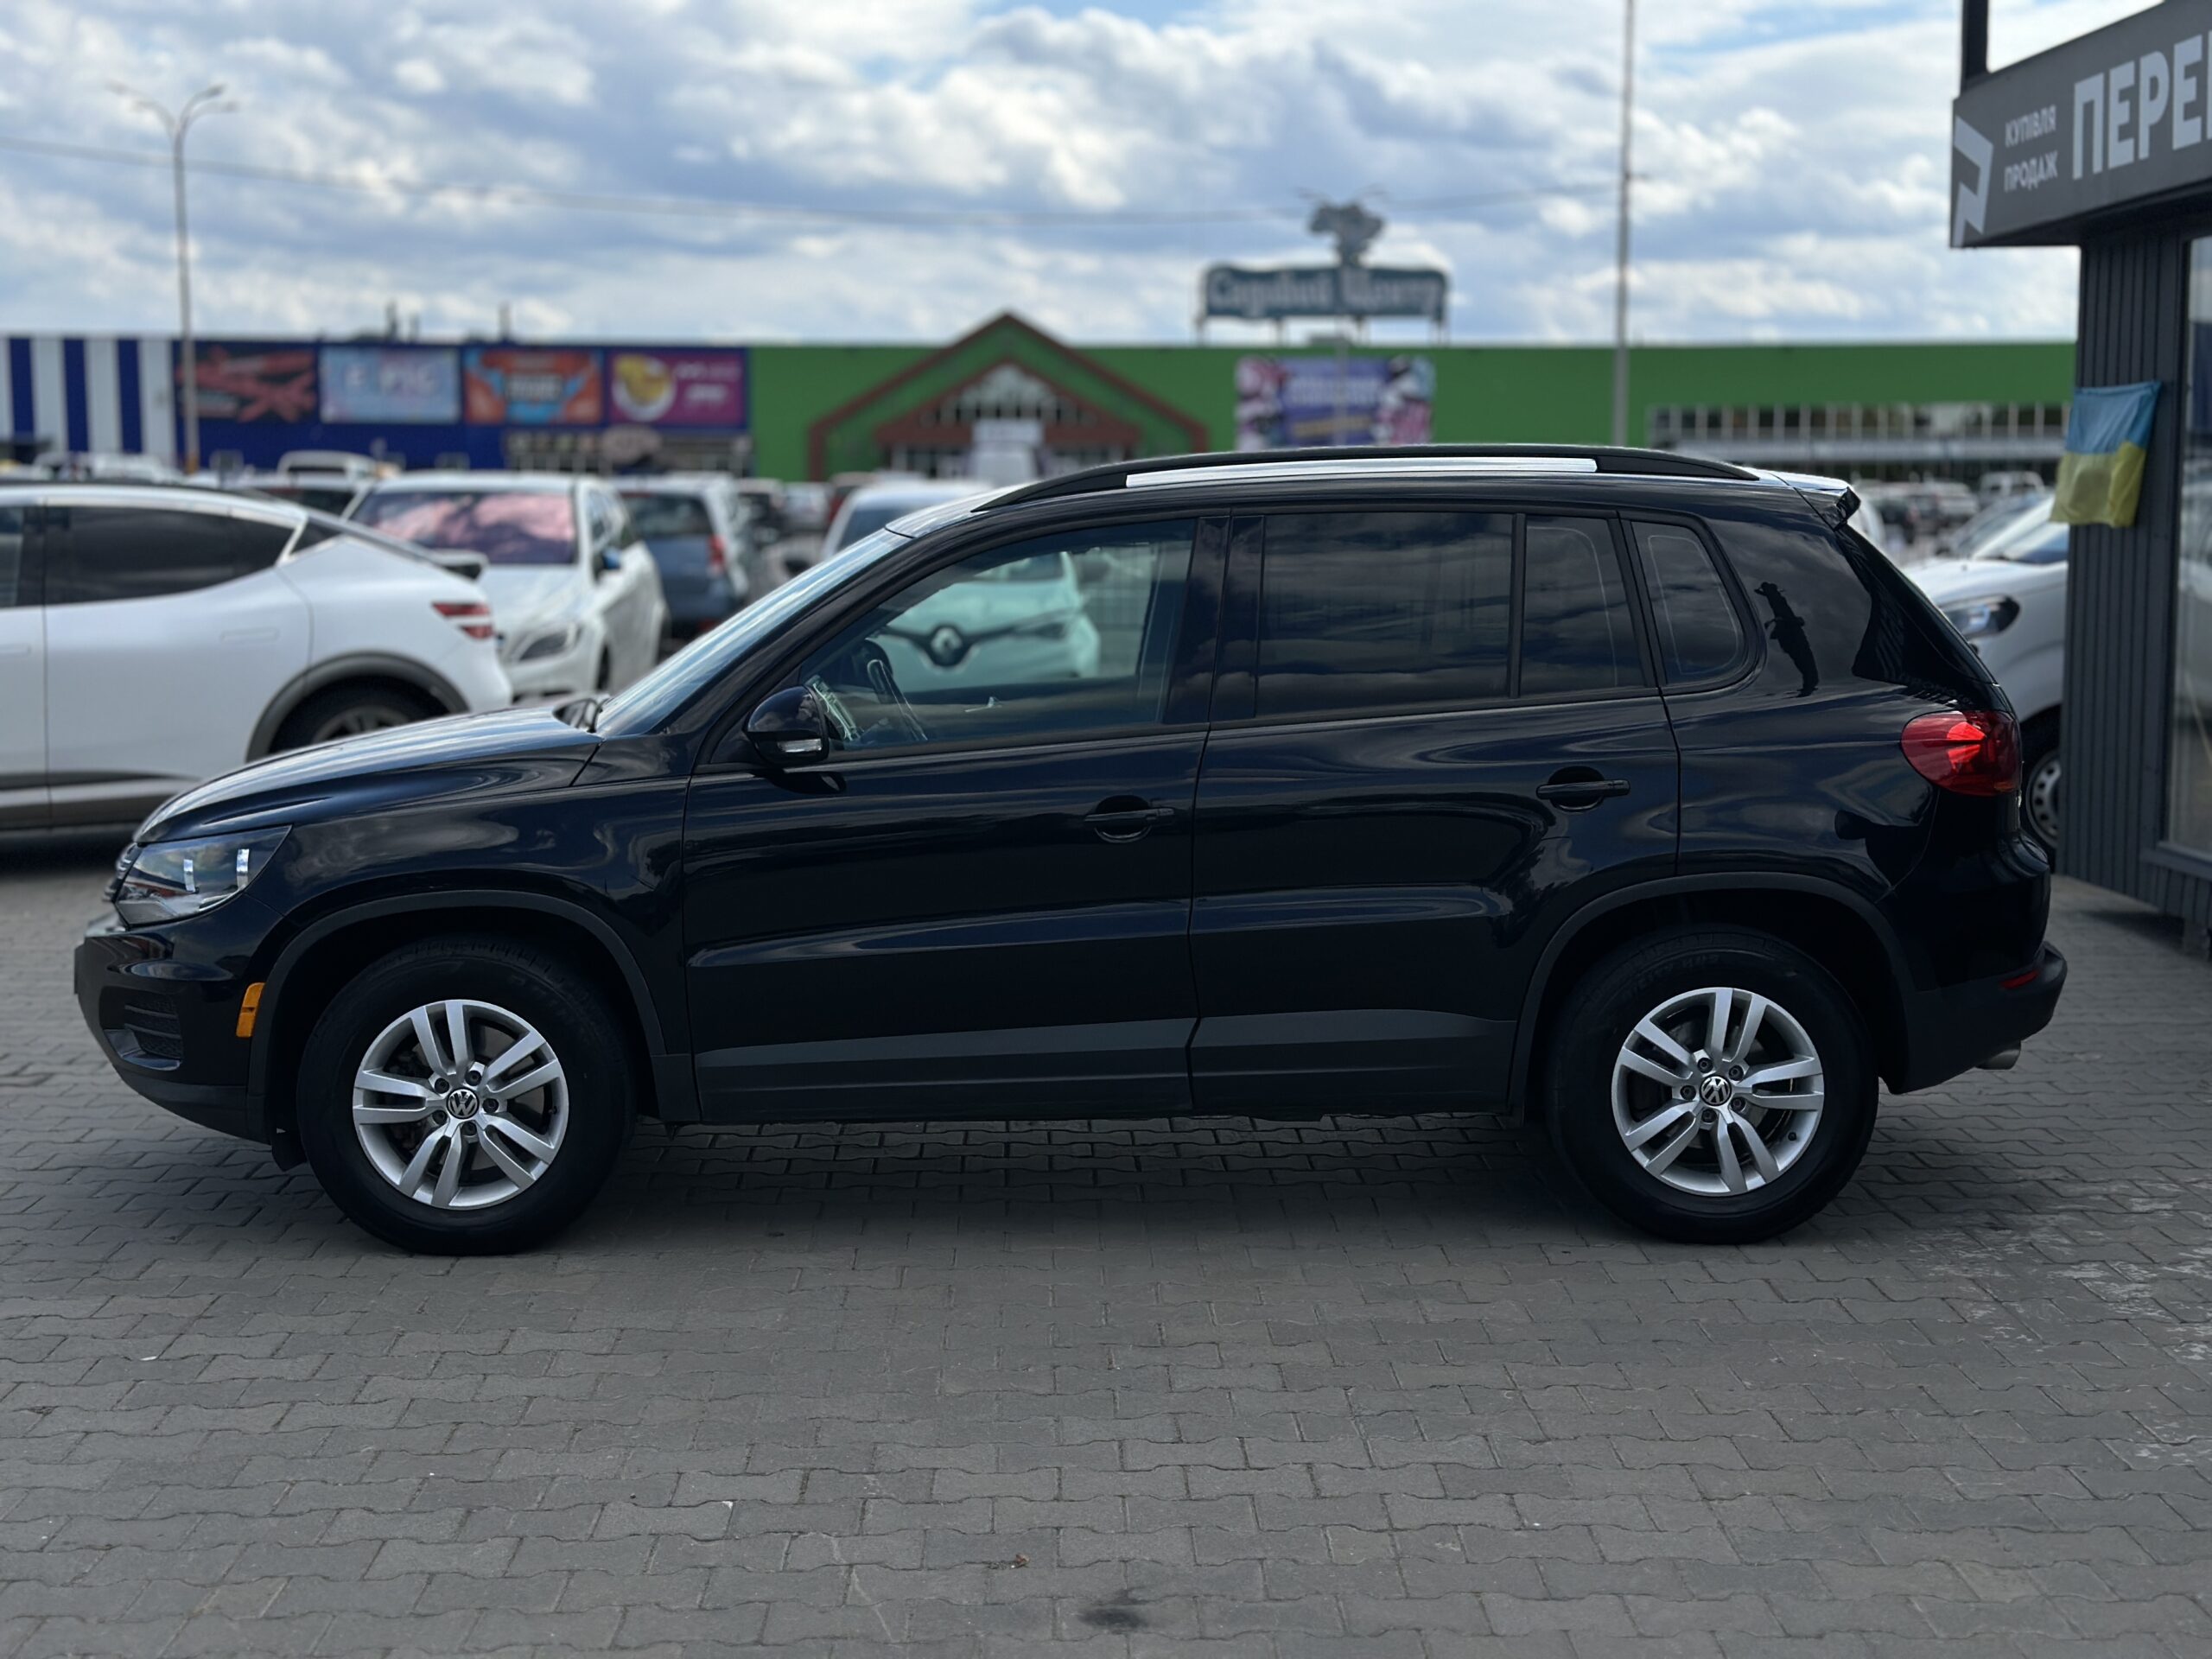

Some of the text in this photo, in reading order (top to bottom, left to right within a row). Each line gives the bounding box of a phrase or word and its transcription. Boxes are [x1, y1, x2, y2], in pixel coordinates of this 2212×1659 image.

[2005, 105, 2056, 148] КУПІВЛЯ
[2072, 30, 2212, 181] ПЕРЕ
[2004, 150, 2058, 192] ПРОДАЖ
